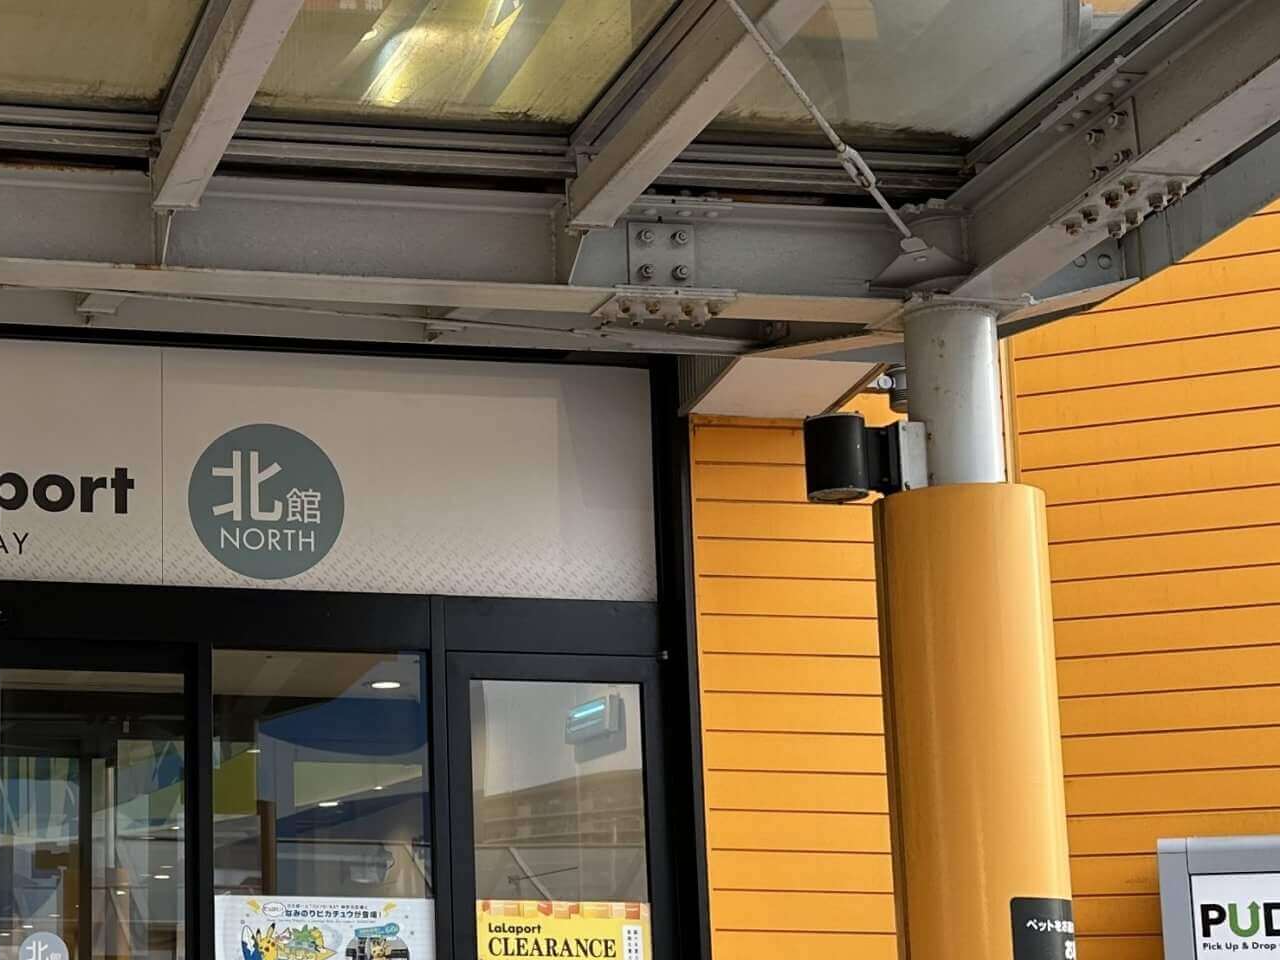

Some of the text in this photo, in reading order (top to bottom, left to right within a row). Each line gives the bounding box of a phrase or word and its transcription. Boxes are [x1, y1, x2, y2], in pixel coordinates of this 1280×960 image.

[212, 449, 322, 525] 北館
[219, 527, 316, 553] NORTH
[488, 922, 542, 936] LaLaport
[488, 936, 617, 958] CLEARANCE
[1202, 942, 1221, 950] Pick
[1225, 942, 1239, 952] Up
[1252, 942, 1277, 951] Drop
